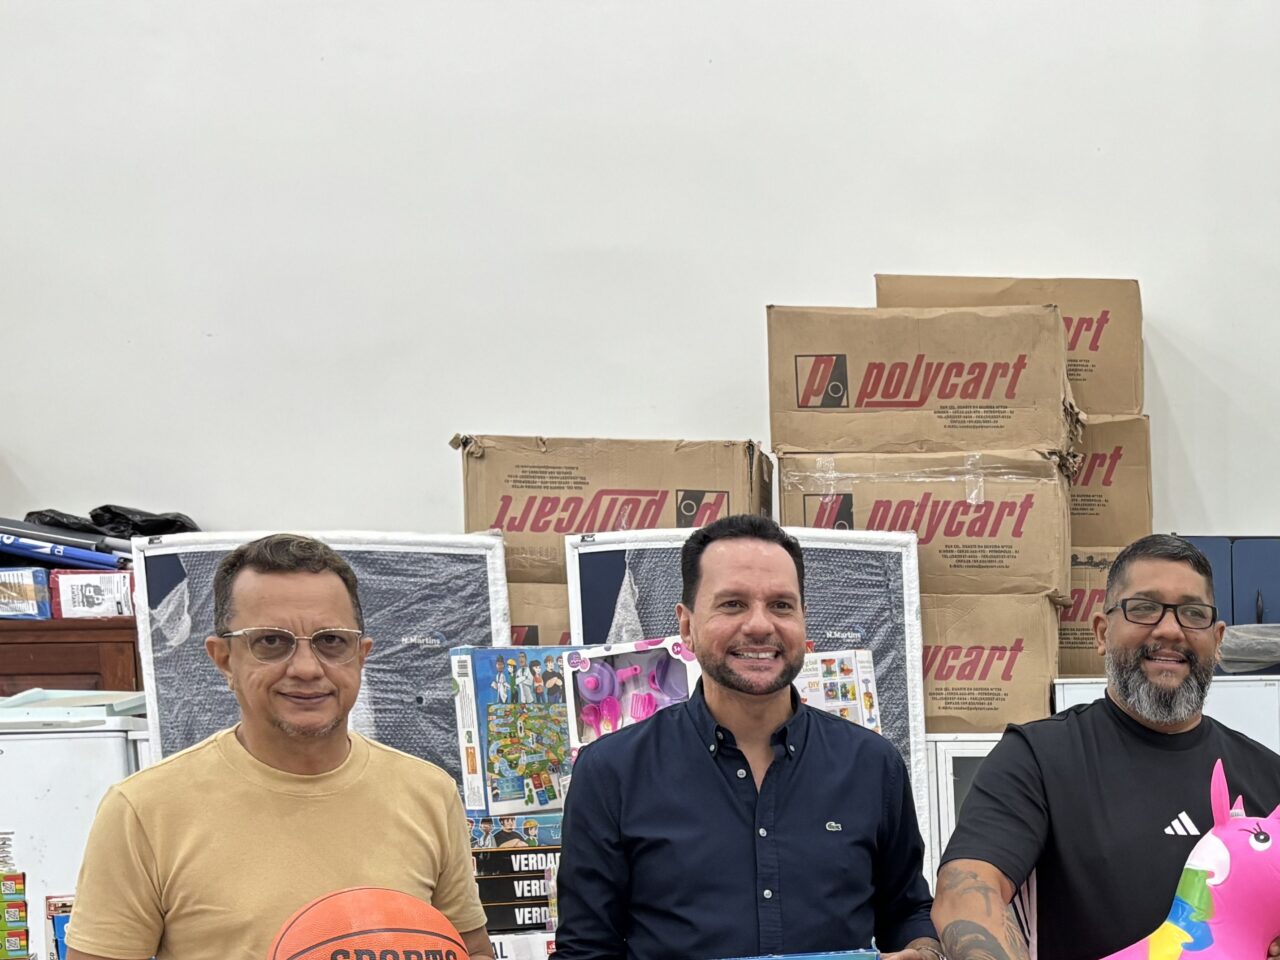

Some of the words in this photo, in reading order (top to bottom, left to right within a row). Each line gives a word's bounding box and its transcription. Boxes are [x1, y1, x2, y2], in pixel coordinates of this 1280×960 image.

[854, 354, 1028, 408] polycart
[490, 489, 669, 533] polycart
[866, 492, 1035, 545] polycart
[923, 638, 1024, 681] ycart
[511, 854, 561, 872] VERDA
[514, 881, 549, 898] VERD
[515, 908, 549, 925] VERD
